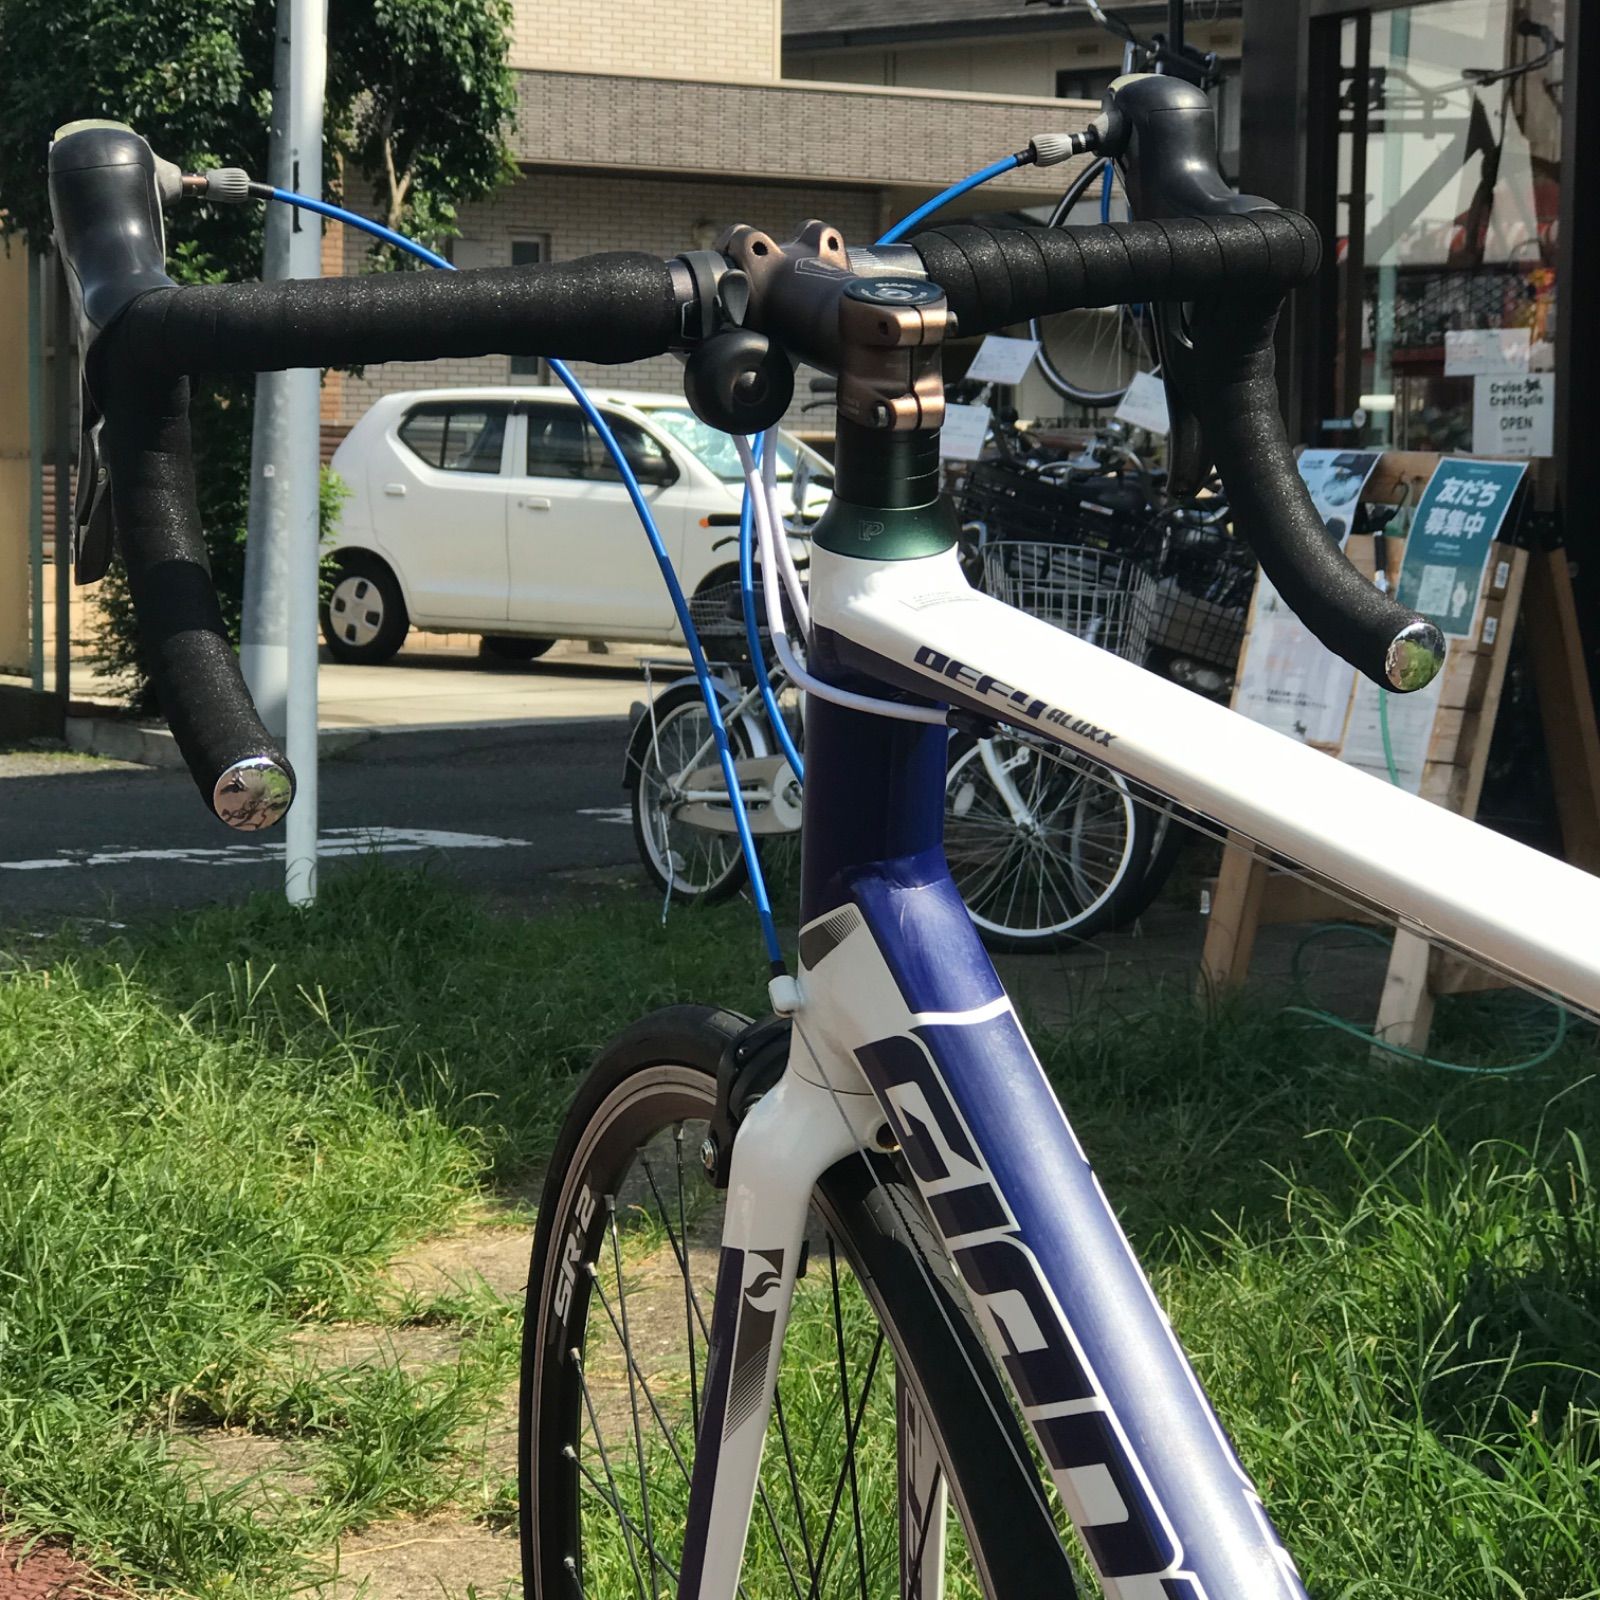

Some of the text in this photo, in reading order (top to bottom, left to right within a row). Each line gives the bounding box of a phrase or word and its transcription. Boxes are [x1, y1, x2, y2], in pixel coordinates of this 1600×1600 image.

[1500, 416, 1533, 431] OPEN
[1424, 507, 1486, 539] 募集中
[1435, 476, 1502, 507] 友だち
[913, 645, 1117, 748] DEFY ALUXX
[554, 1183, 596, 1327] SR-2
[853, 1034, 1190, 1600] GIAN
